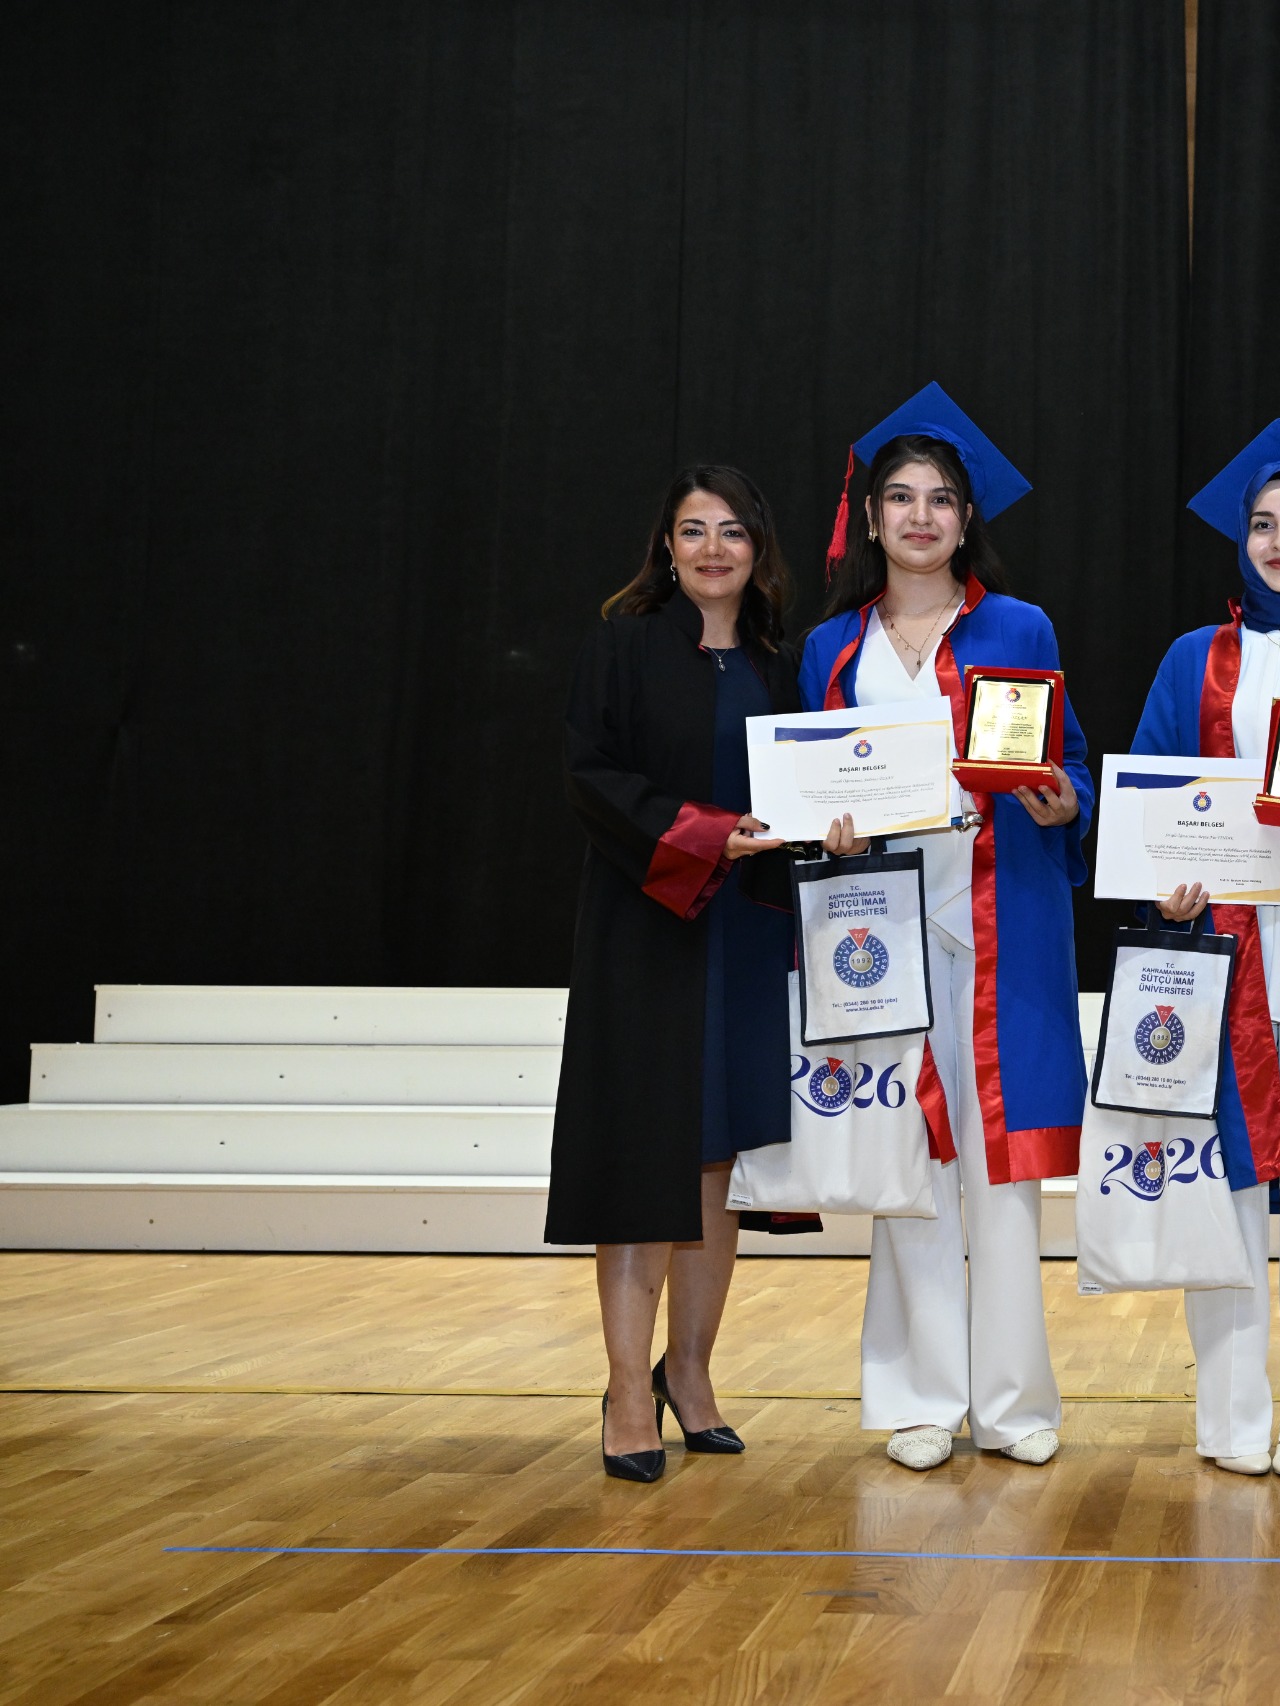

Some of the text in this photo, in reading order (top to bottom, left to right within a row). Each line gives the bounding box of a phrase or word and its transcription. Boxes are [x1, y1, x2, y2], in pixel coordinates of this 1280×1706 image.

[862, 764, 887, 772] BELGESİ
[828, 890, 885, 900] KAHRAMANMARAŞ
[828, 897, 886, 909] SÜTÇÜ İMAM
[828, 906, 888, 920] ÜNİVERSİTESİ
[1142, 967, 1195, 977] KAHRAMANMARAŞ
[1140, 972, 1195, 986] SÜTÇÜ İMAM
[1138, 982, 1194, 996] ÜNİVERSİTESİ
